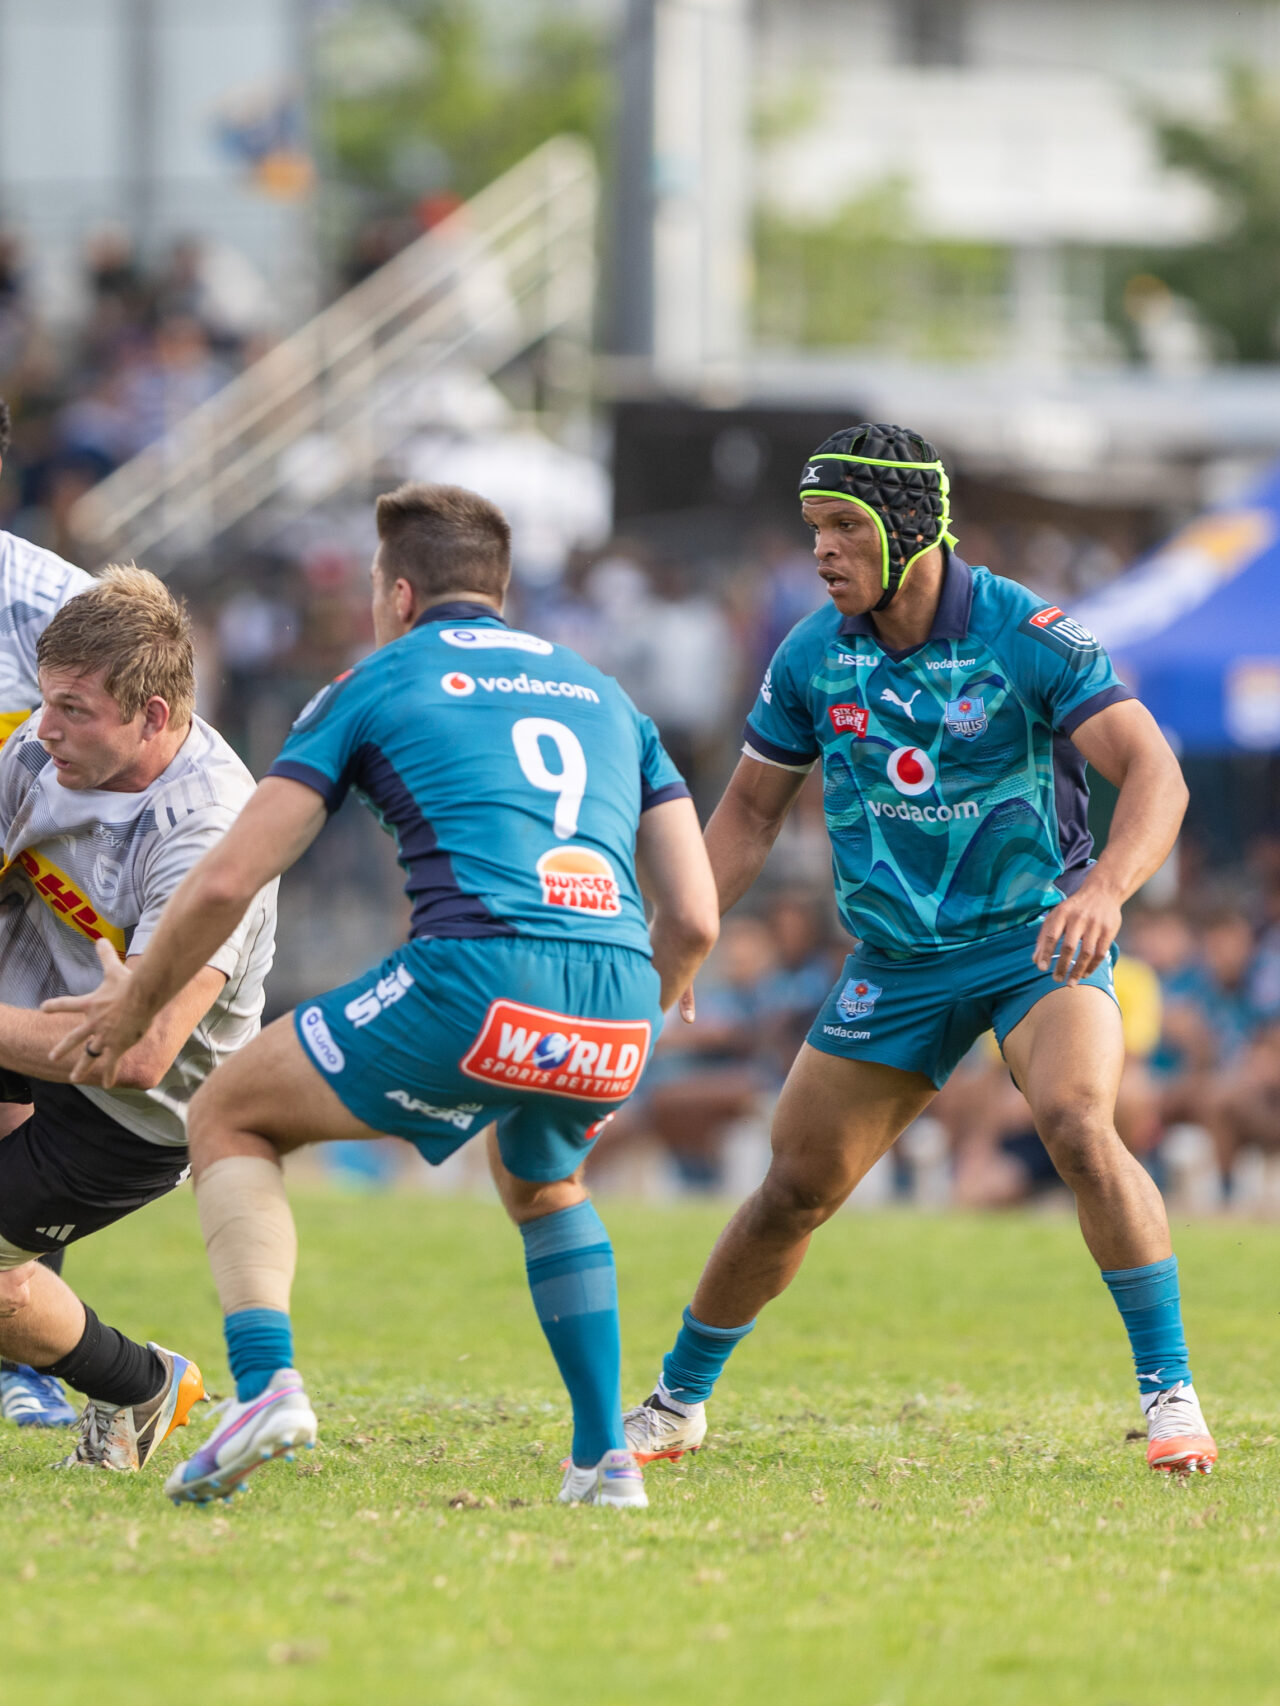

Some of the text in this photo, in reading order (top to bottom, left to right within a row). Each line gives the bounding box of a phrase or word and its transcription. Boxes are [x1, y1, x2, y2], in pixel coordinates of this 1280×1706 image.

[925, 657, 976, 671] vodacom
[477, 672, 600, 704] vodacom
[512, 717, 587, 840] 9
[867, 799, 980, 823] vodacom
[18, 850, 104, 940] DHL
[545, 874, 613, 892] BURGER
[548, 887, 617, 911] KING
[823, 1024, 871, 1040] vodacom
[497, 1021, 640, 1079] WORLD
[480, 1057, 631, 1093] SPORTS BETTING
